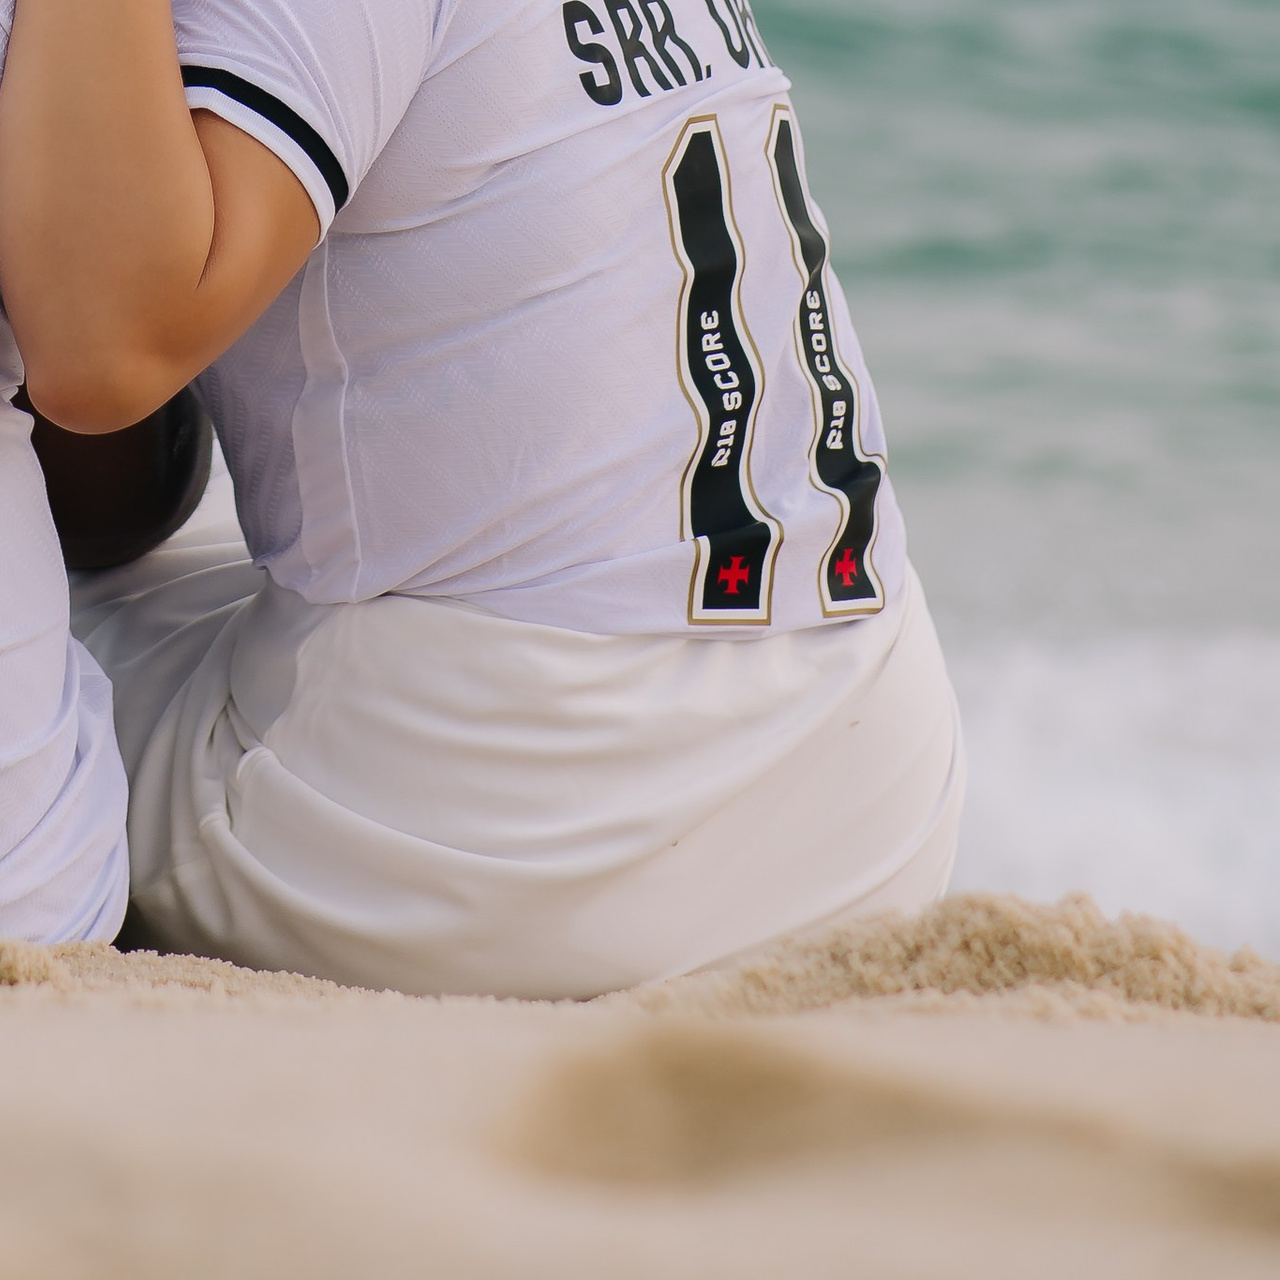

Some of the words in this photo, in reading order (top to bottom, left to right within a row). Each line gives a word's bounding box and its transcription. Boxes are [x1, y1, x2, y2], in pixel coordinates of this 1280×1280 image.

[661, 103, 888, 626] 11
[700, 309, 742, 411] SCORE
[805, 290, 842, 391] SCORE
